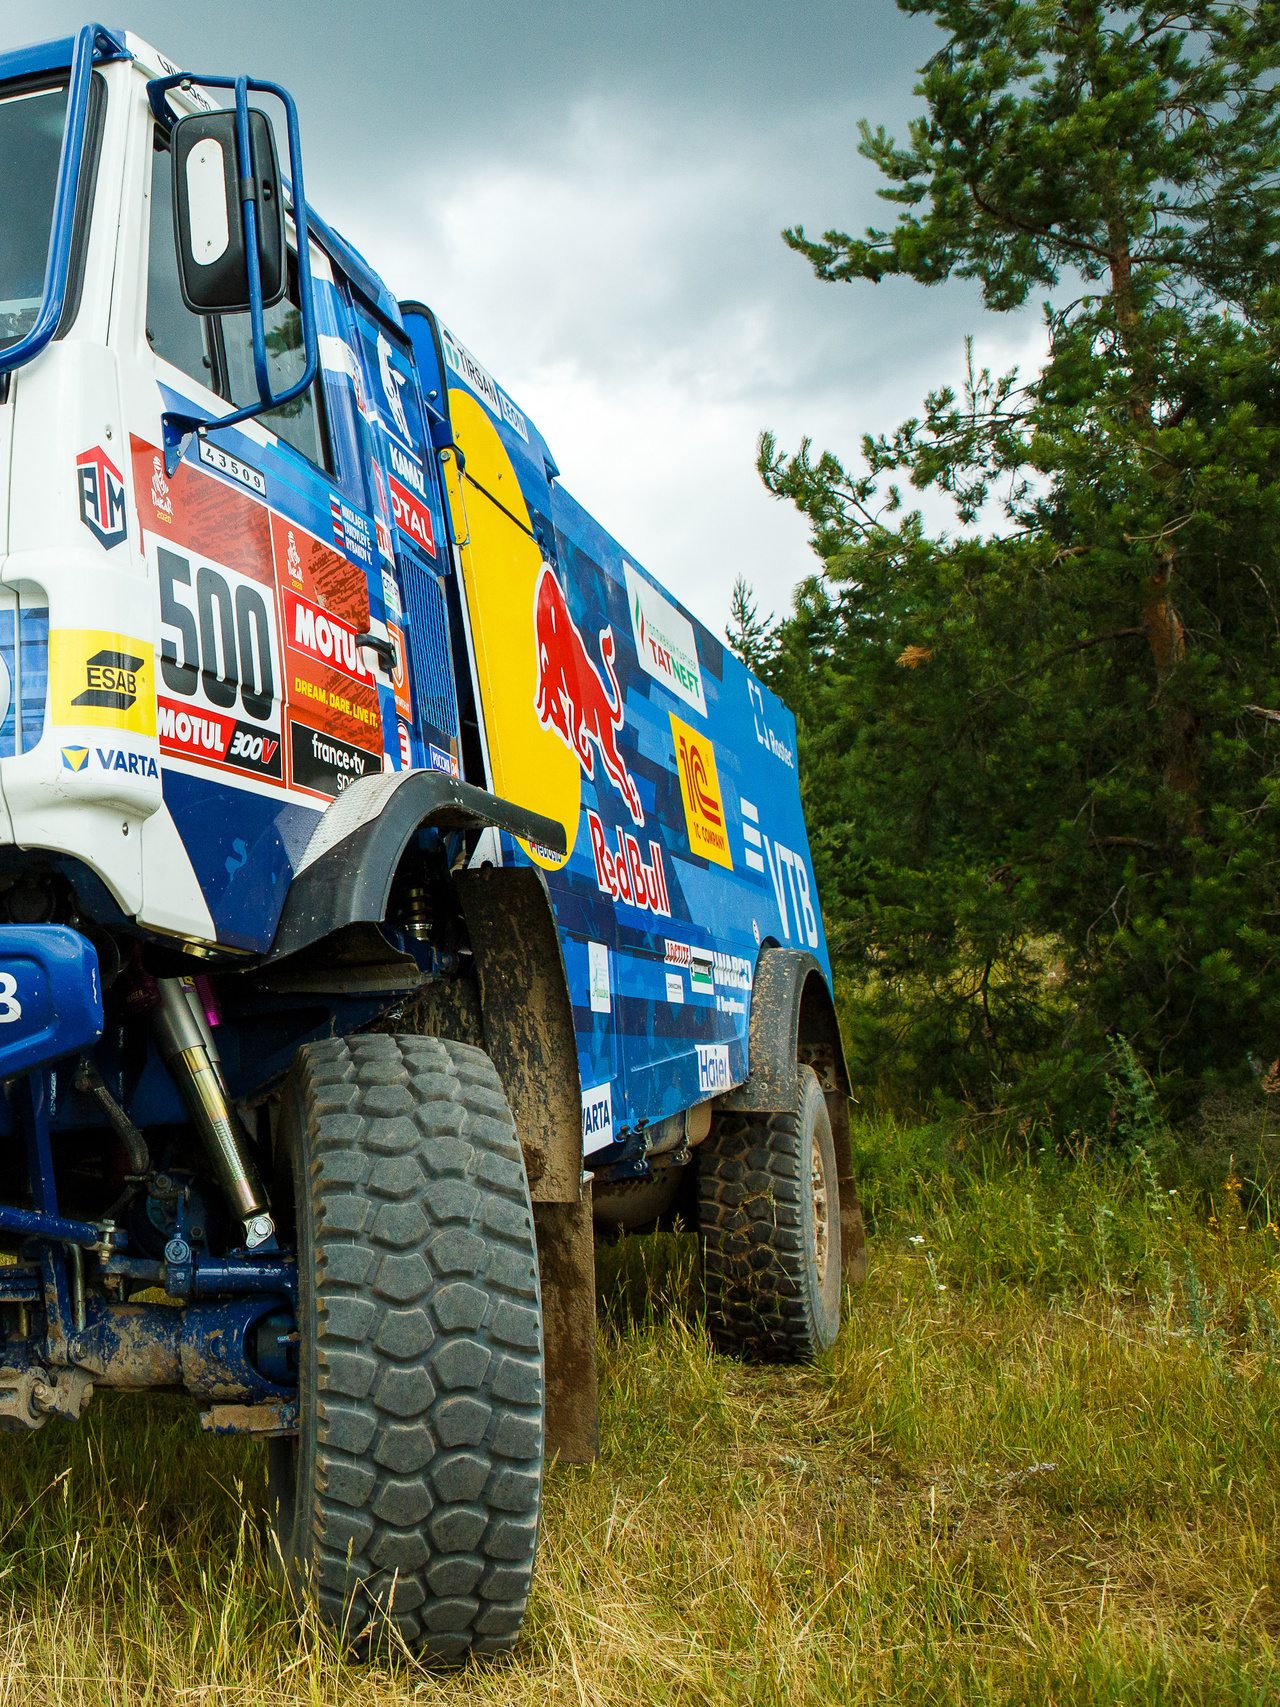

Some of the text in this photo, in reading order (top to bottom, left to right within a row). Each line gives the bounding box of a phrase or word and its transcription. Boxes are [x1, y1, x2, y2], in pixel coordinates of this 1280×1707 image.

[389, 442, 427, 499] KAMAZ
[156, 509, 172, 524] 2020
[157, 546, 275, 722] 500
[86, 667, 137, 694] ESAB
[648, 637, 700, 699] TATNEFT
[295, 676, 329, 705] DREAM.
[329, 692, 353, 716] DARE.
[353, 704, 369, 727] LIVE
[158, 706, 279, 765] MOTUL 300V
[95, 747, 159, 780] VARTA
[586, 811, 671, 915] Red Bull
[762, 834, 819, 949] VTB
[665, 942, 689, 965] LOCTITE
[713, 951, 753, 990] WABCO
[699, 1048, 729, 1089] Haier
